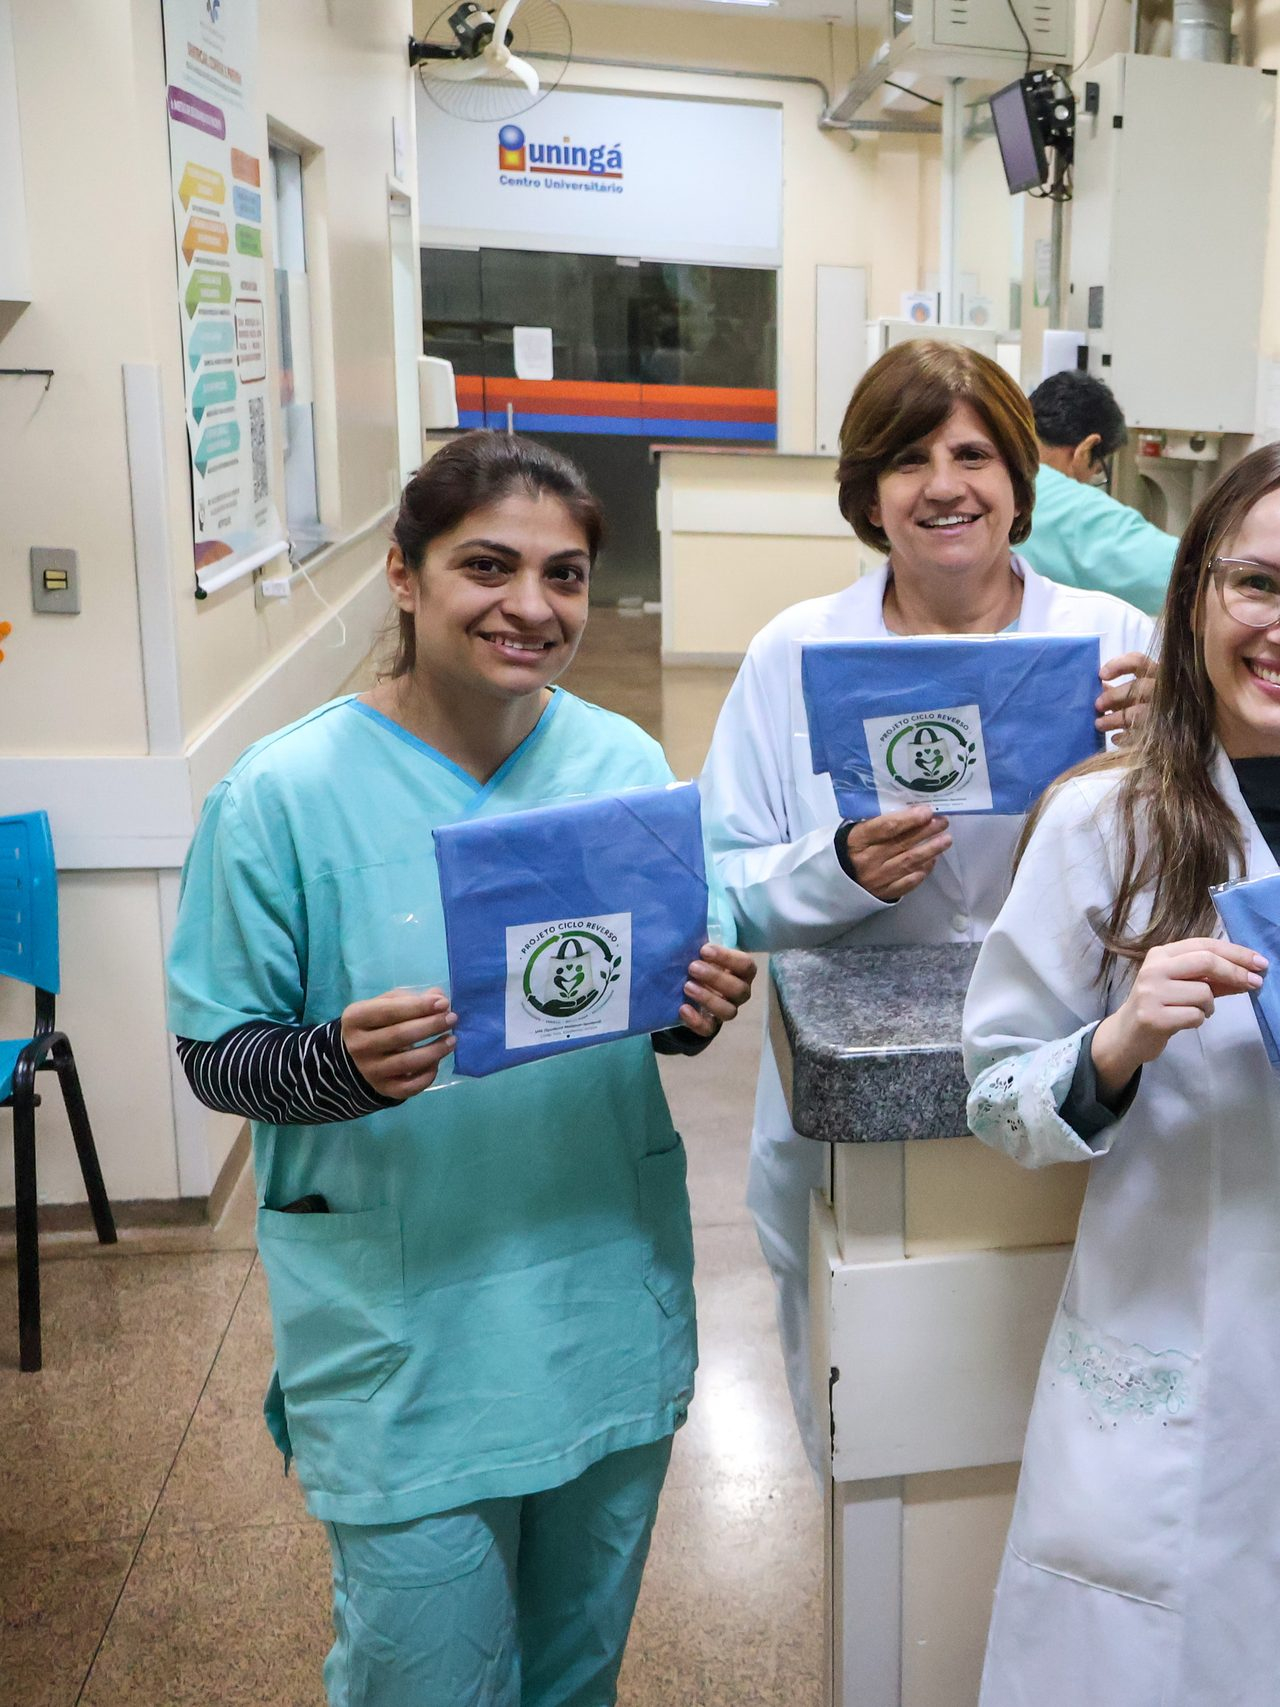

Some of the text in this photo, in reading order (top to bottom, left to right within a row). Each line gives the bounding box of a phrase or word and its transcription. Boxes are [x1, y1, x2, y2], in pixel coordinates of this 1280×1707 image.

[529, 136, 624, 175] uningá
[499, 175, 624, 194] Centro Universitário
[880, 713, 969, 742] PROJETO CICLO REVERSO
[521, 921, 618, 954] PROJETO CICLO REVERSO
